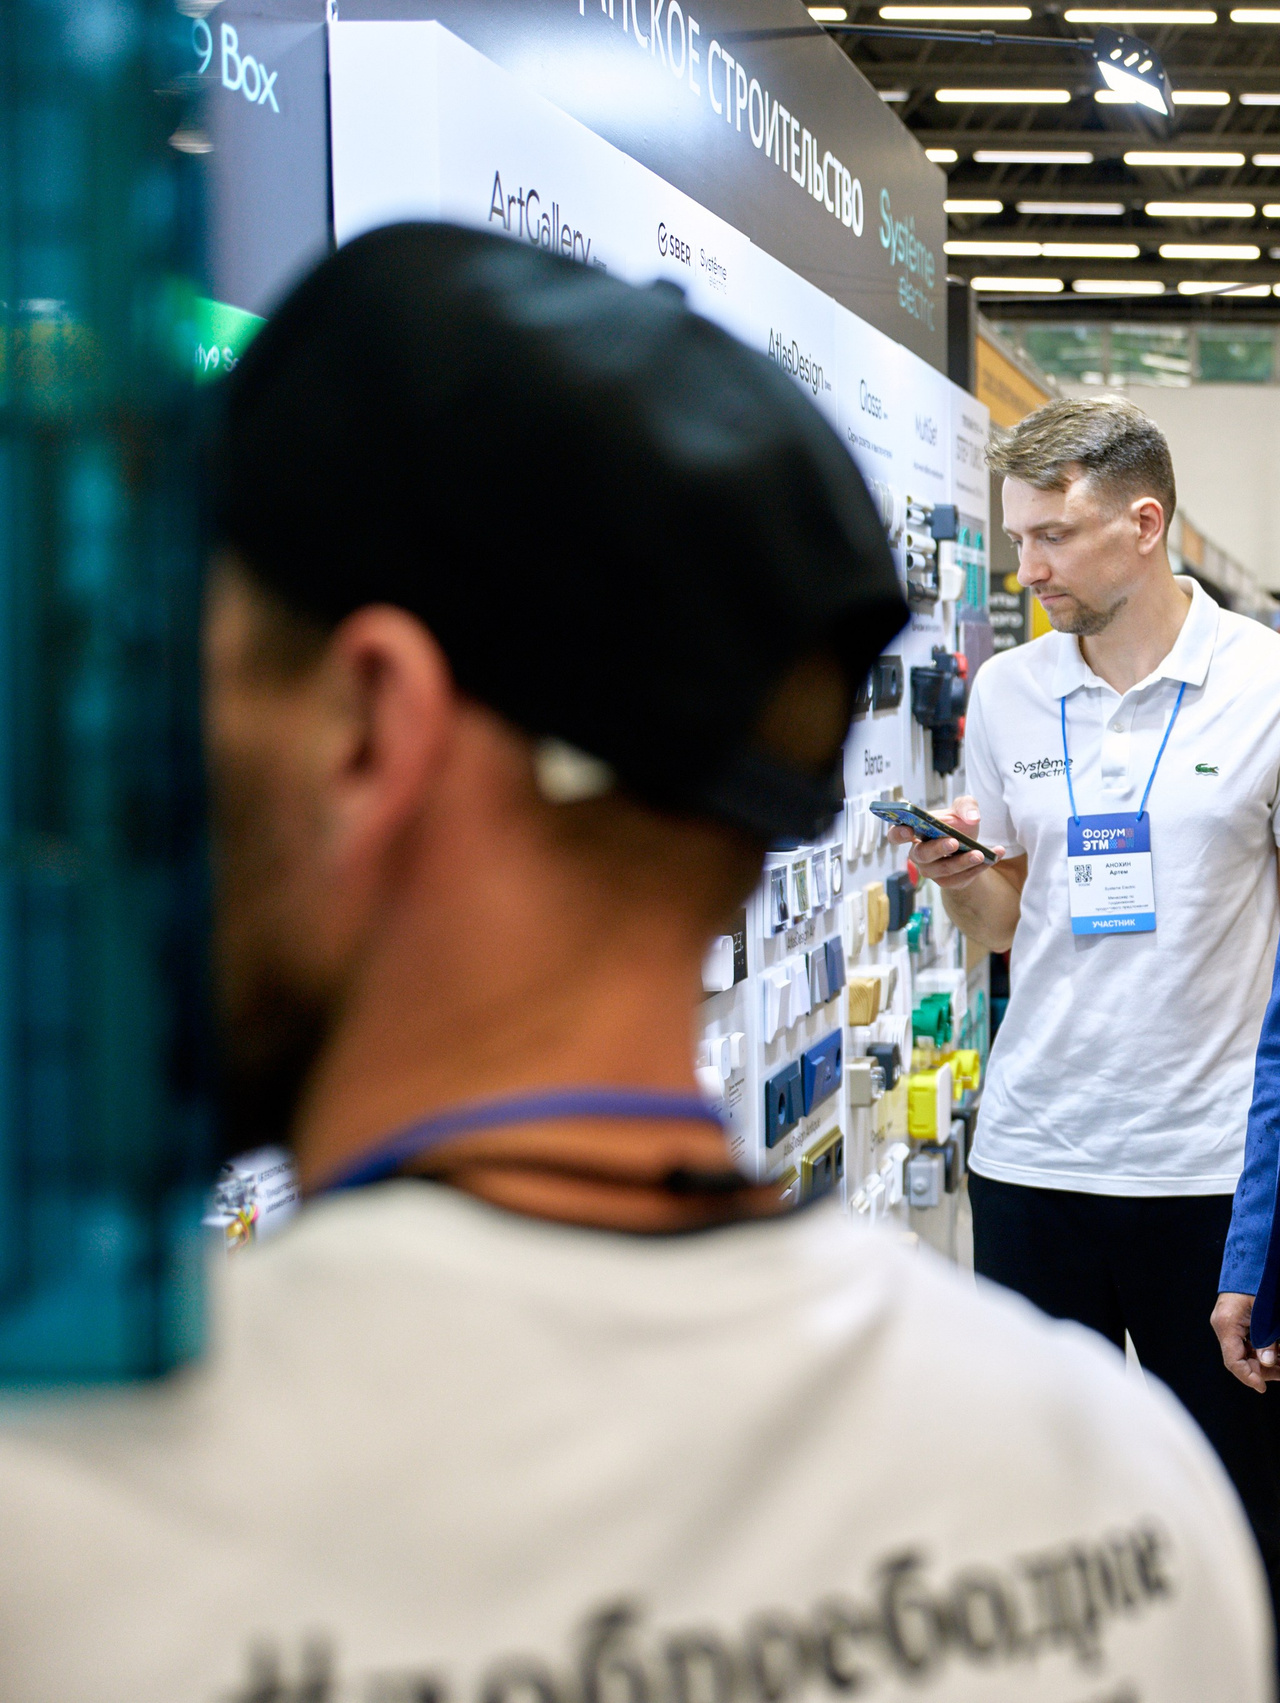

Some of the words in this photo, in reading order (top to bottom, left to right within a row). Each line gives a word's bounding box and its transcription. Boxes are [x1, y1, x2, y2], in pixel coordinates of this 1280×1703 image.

[221, 22, 280, 113] Box
[707, 39, 864, 237] СТРОИТЕЛЬСТВО
[488, 169, 592, 265] ArtGallery
[669, 234, 691, 267] SBER
[767, 327, 824, 396] AtlasDesign
[1082, 827, 1126, 840] Форум
[1082, 839, 1109, 851] ЭТМ
[1105, 861, 1132, 869] АНОХИН
[1092, 918, 1136, 929] УЧАСТНИК
